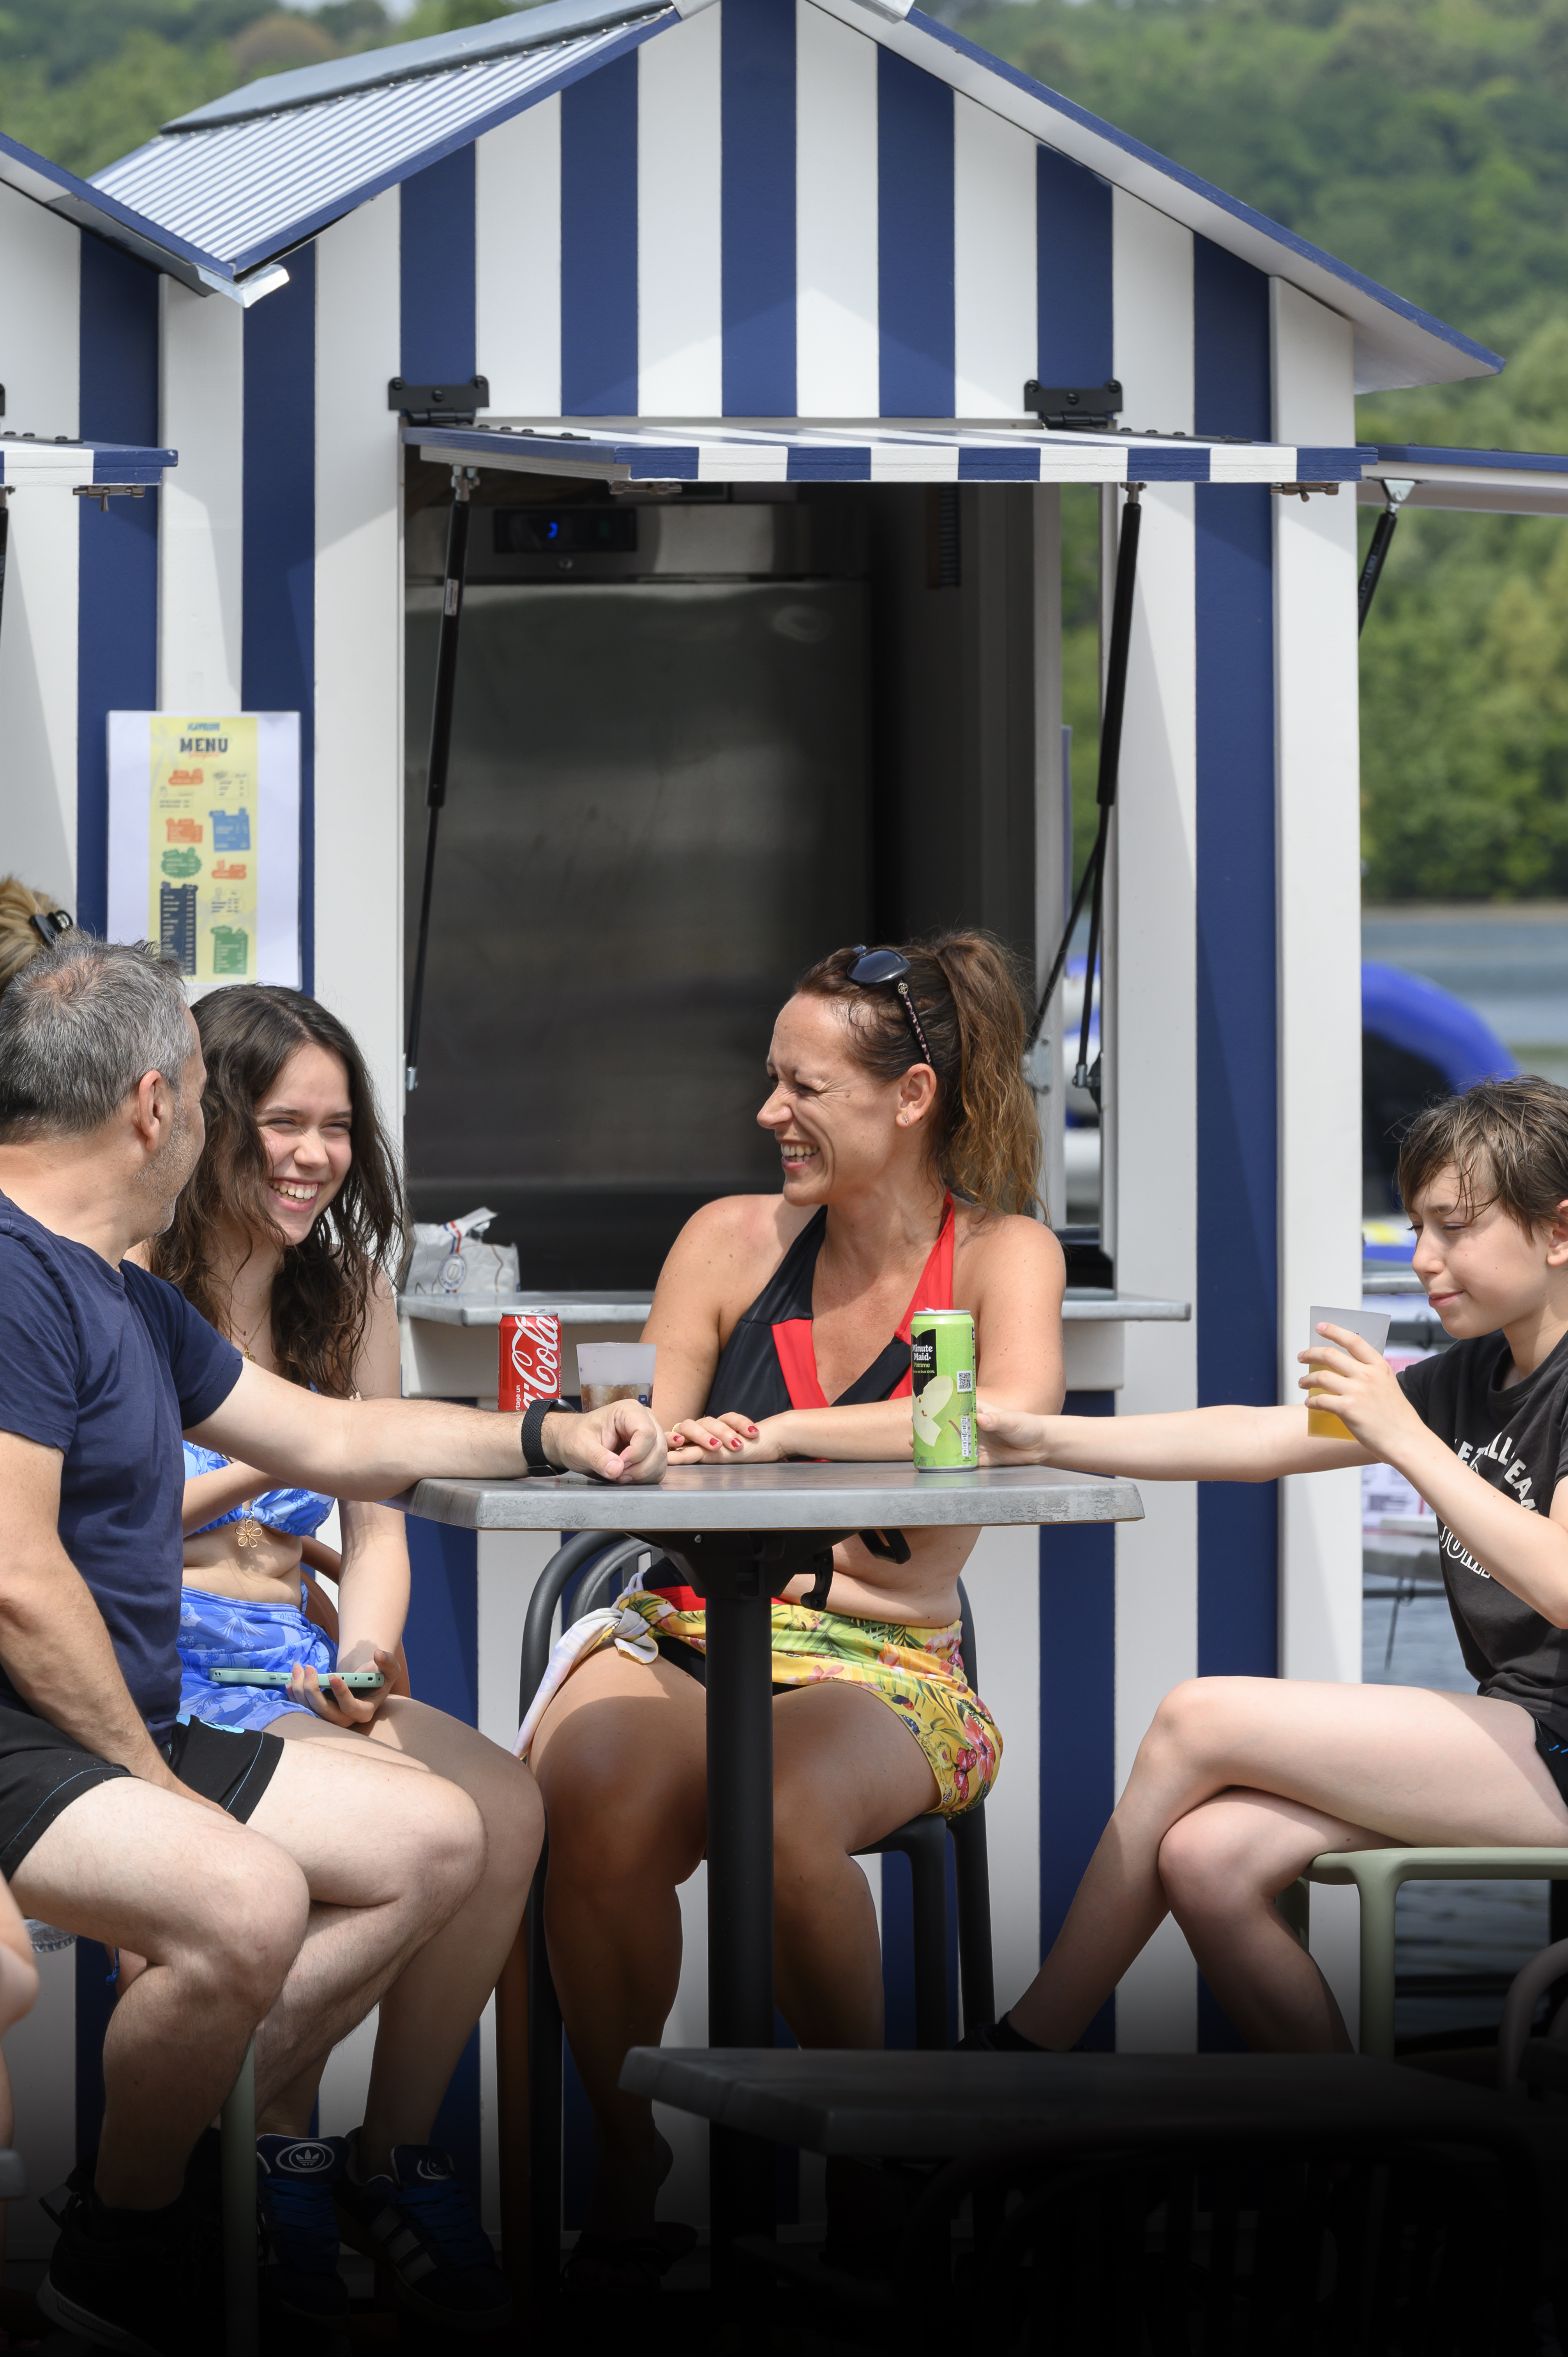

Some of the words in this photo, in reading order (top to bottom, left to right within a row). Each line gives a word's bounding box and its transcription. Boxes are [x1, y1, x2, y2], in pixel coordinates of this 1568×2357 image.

[180, 737, 228, 753] MENU
[912, 1344, 933, 1352] Minute
[914, 1353, 929, 1361] Maid
